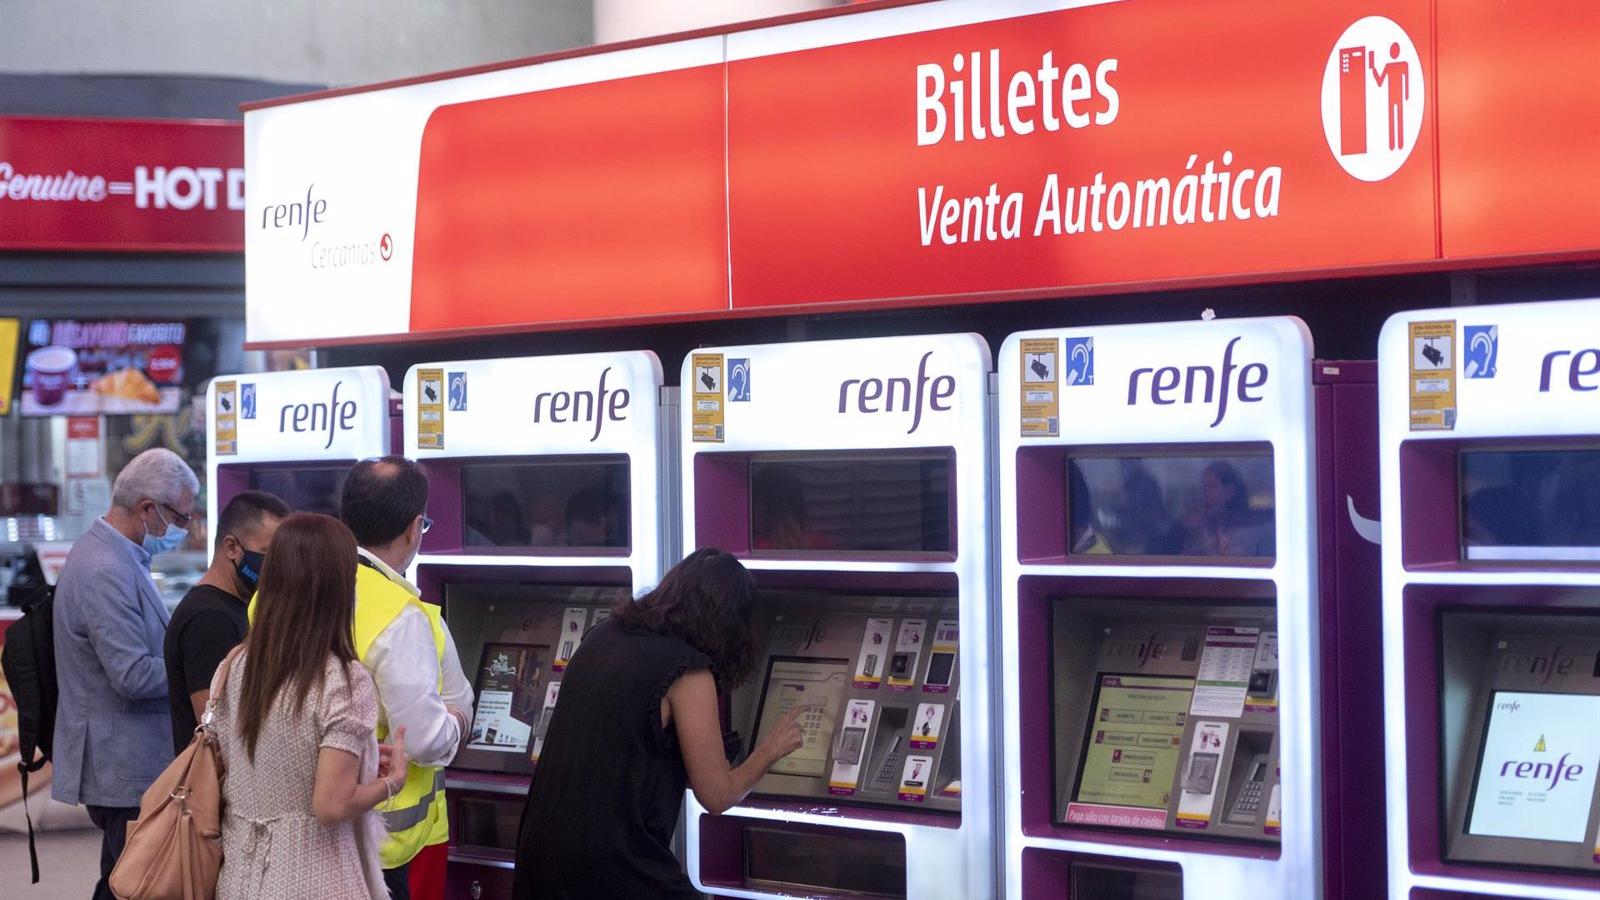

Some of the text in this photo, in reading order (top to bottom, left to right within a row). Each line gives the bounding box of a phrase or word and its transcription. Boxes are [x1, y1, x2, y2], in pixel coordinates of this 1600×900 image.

[916, 48, 1120, 147] Billetes
[0, 162, 107, 201] Genuine
[134, 166, 223, 210] HOT
[262, 184, 327, 241] renfe
[918, 150, 1282, 247] Venta Automática
[279, 381, 357, 449] renfe
[533, 366, 630, 442] renfe
[838, 350, 956, 435] renfe
[1128, 335, 1269, 428] renfe
[1499, 752, 1584, 792] renfe
